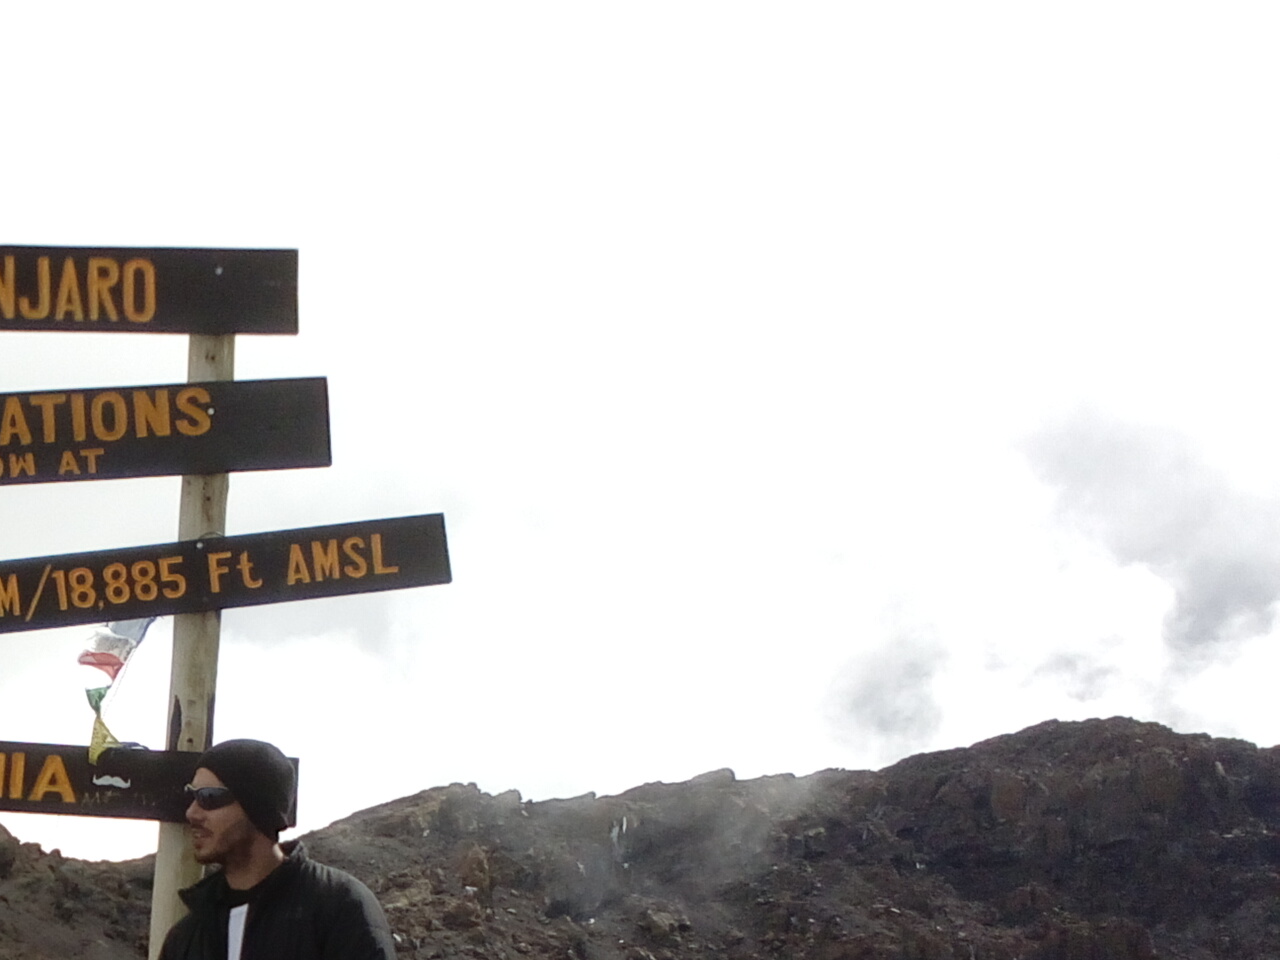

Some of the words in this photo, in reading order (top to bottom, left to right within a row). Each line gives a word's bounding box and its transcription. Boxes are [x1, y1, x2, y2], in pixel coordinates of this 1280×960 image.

[58, 447, 105, 474] AT
[207, 551, 264, 593] Ft
[286, 533, 399, 584] AMSL
